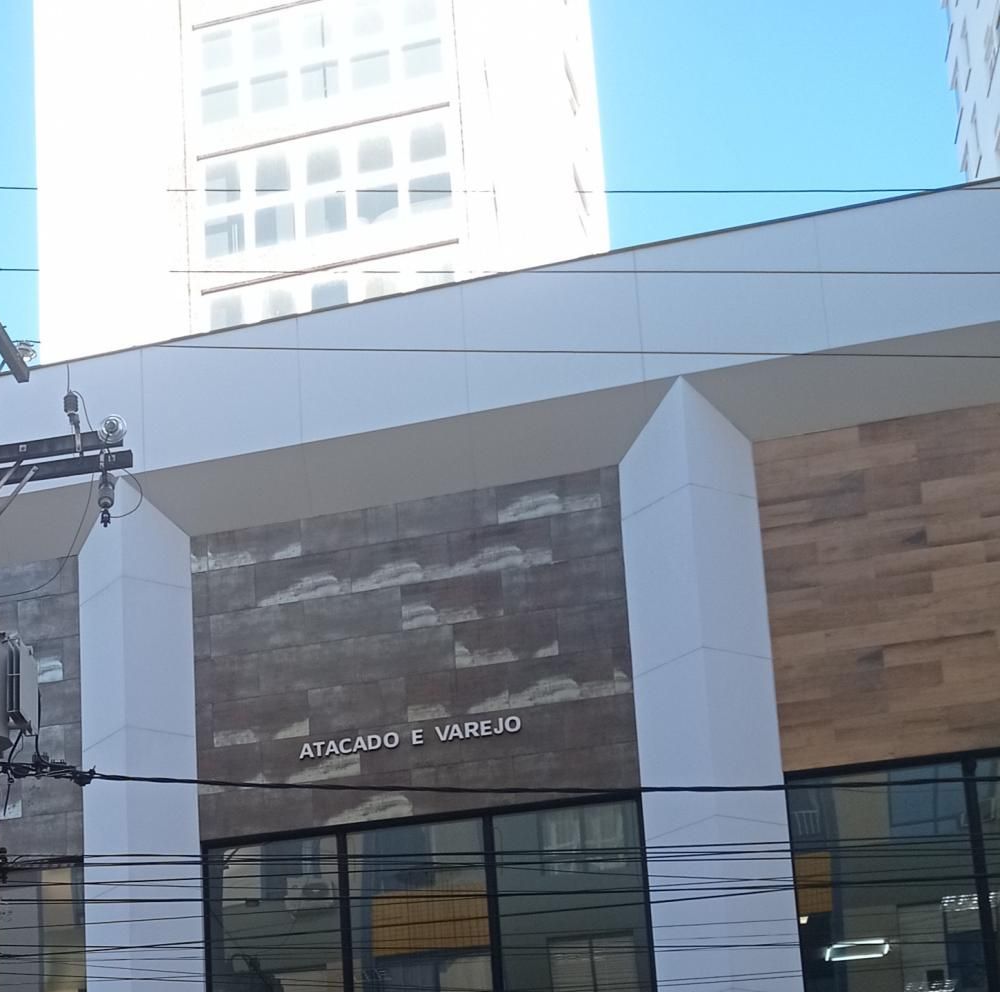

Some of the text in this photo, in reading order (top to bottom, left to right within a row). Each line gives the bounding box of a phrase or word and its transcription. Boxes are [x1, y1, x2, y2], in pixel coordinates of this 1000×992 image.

[299, 716, 522, 759] ATACADO E VAREJO
